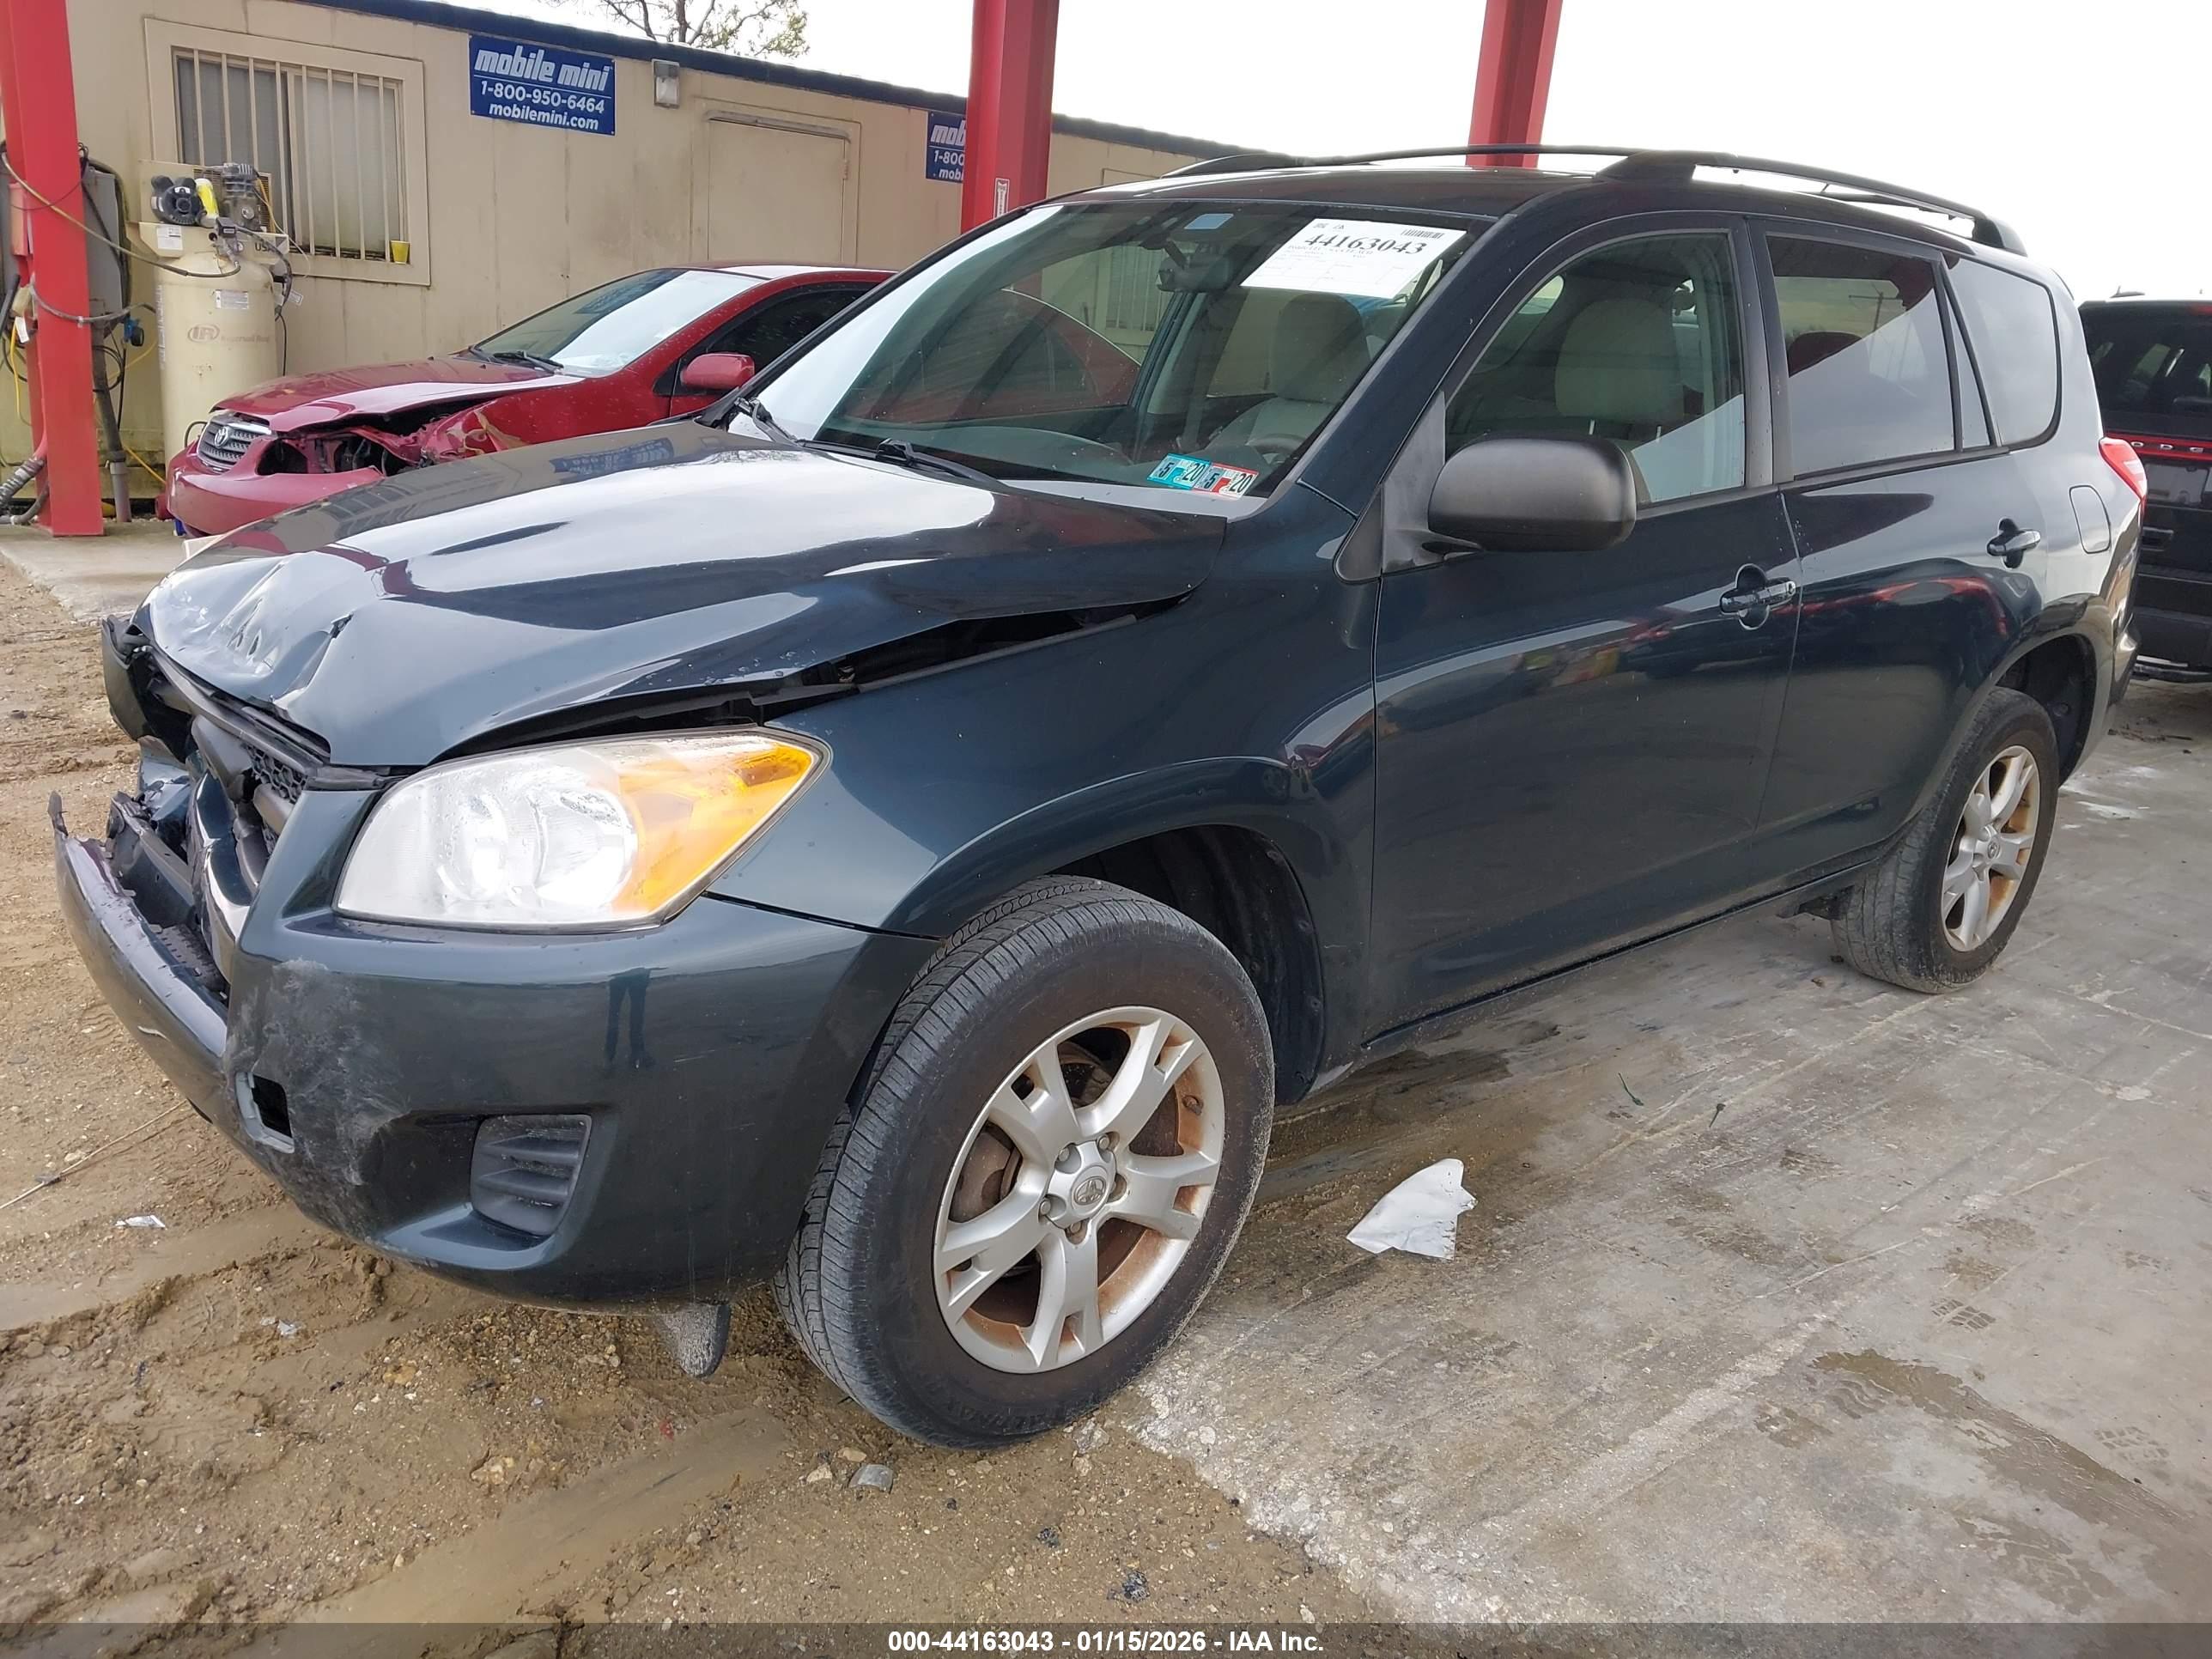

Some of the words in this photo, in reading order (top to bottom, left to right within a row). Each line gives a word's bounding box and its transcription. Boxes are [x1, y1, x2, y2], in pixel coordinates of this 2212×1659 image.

[474, 46, 555, 82] mobile
[556, 62, 611, 91] mini
[481, 81, 605, 114] 1-800-950-6464
[489, 102, 599, 131] mobilemini.com
[1305, 234, 1428, 255] 44163043
[1182, 462, 1206, 482] 20
[1229, 472, 1253, 493] 20
